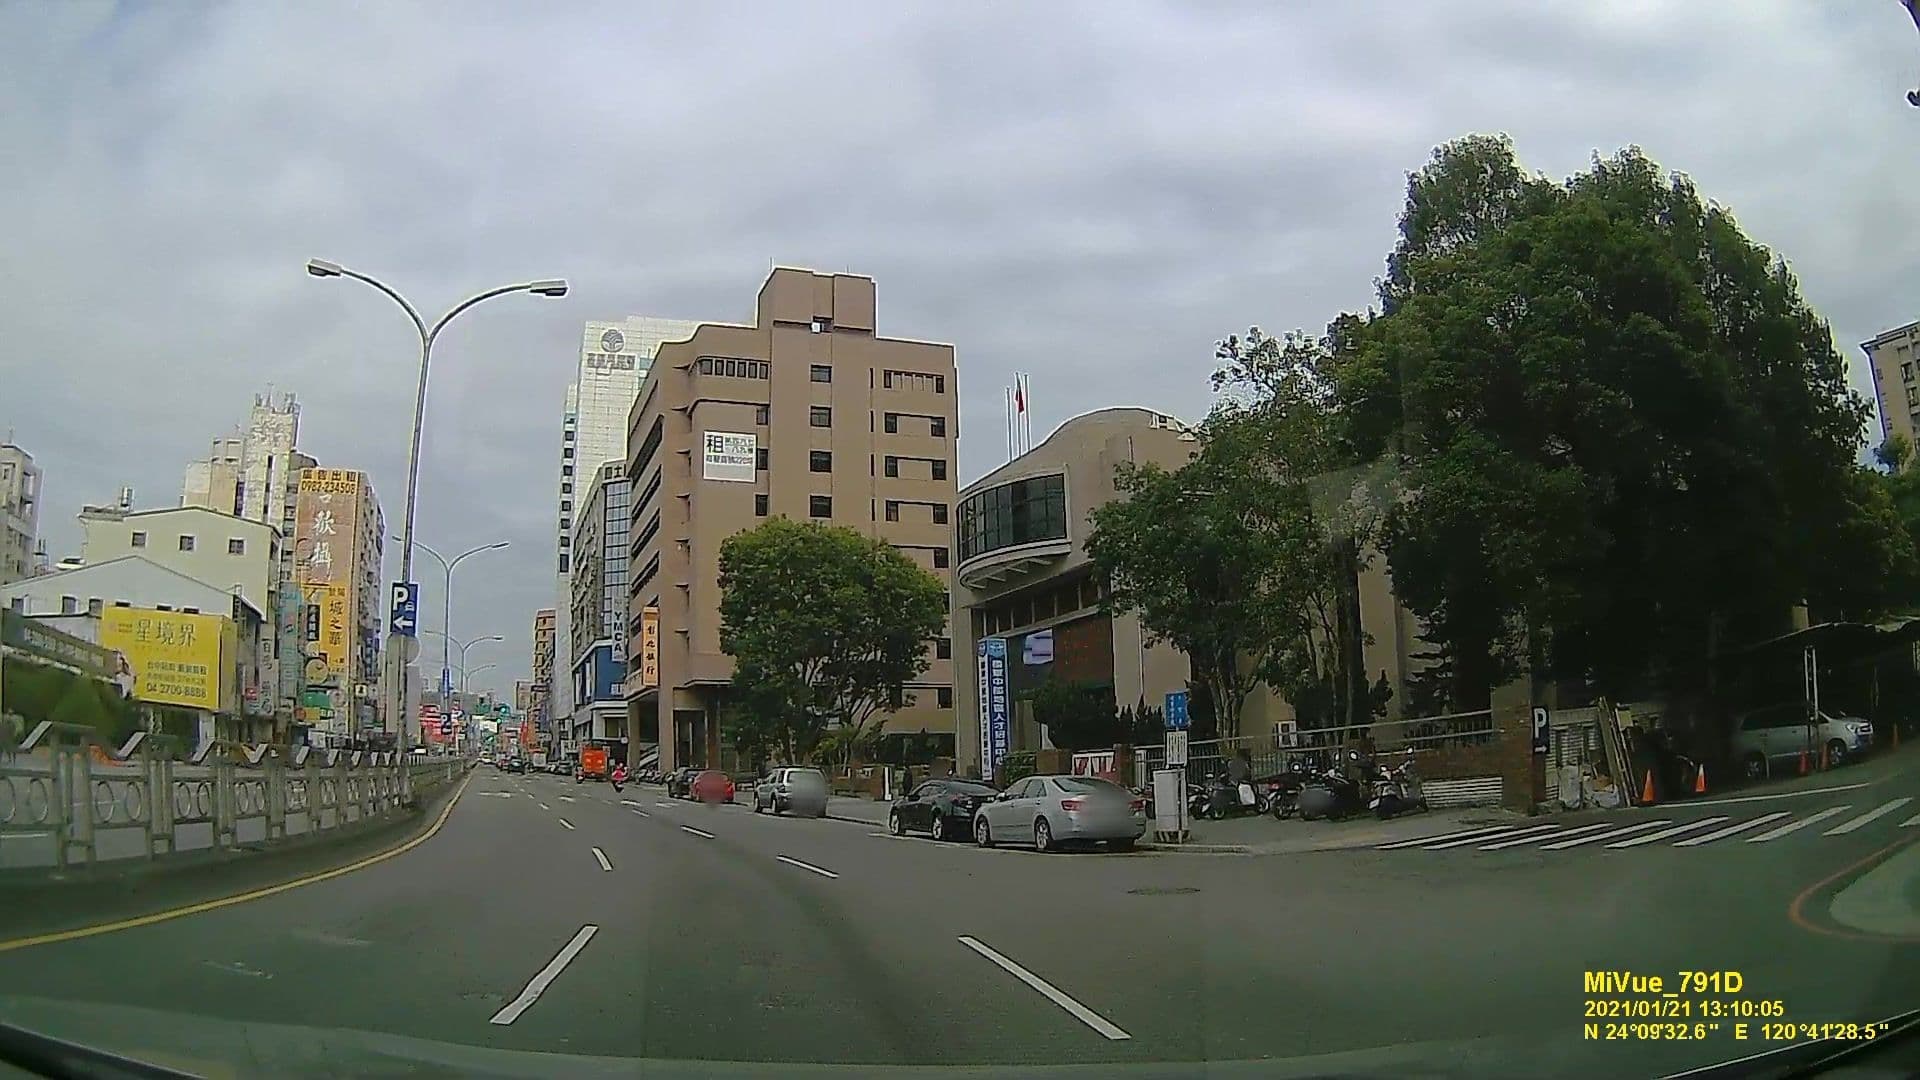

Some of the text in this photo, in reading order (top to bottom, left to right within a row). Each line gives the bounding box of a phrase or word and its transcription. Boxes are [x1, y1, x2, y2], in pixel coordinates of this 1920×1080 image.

[706, 434, 724, 454] 租
[302, 469, 357, 482] 廣告出租
[392, 586, 409, 611] P
[135, 618, 197, 647] 星境界
[612, 611, 623, 652] YMCA
[1534, 707, 1547, 739] P
